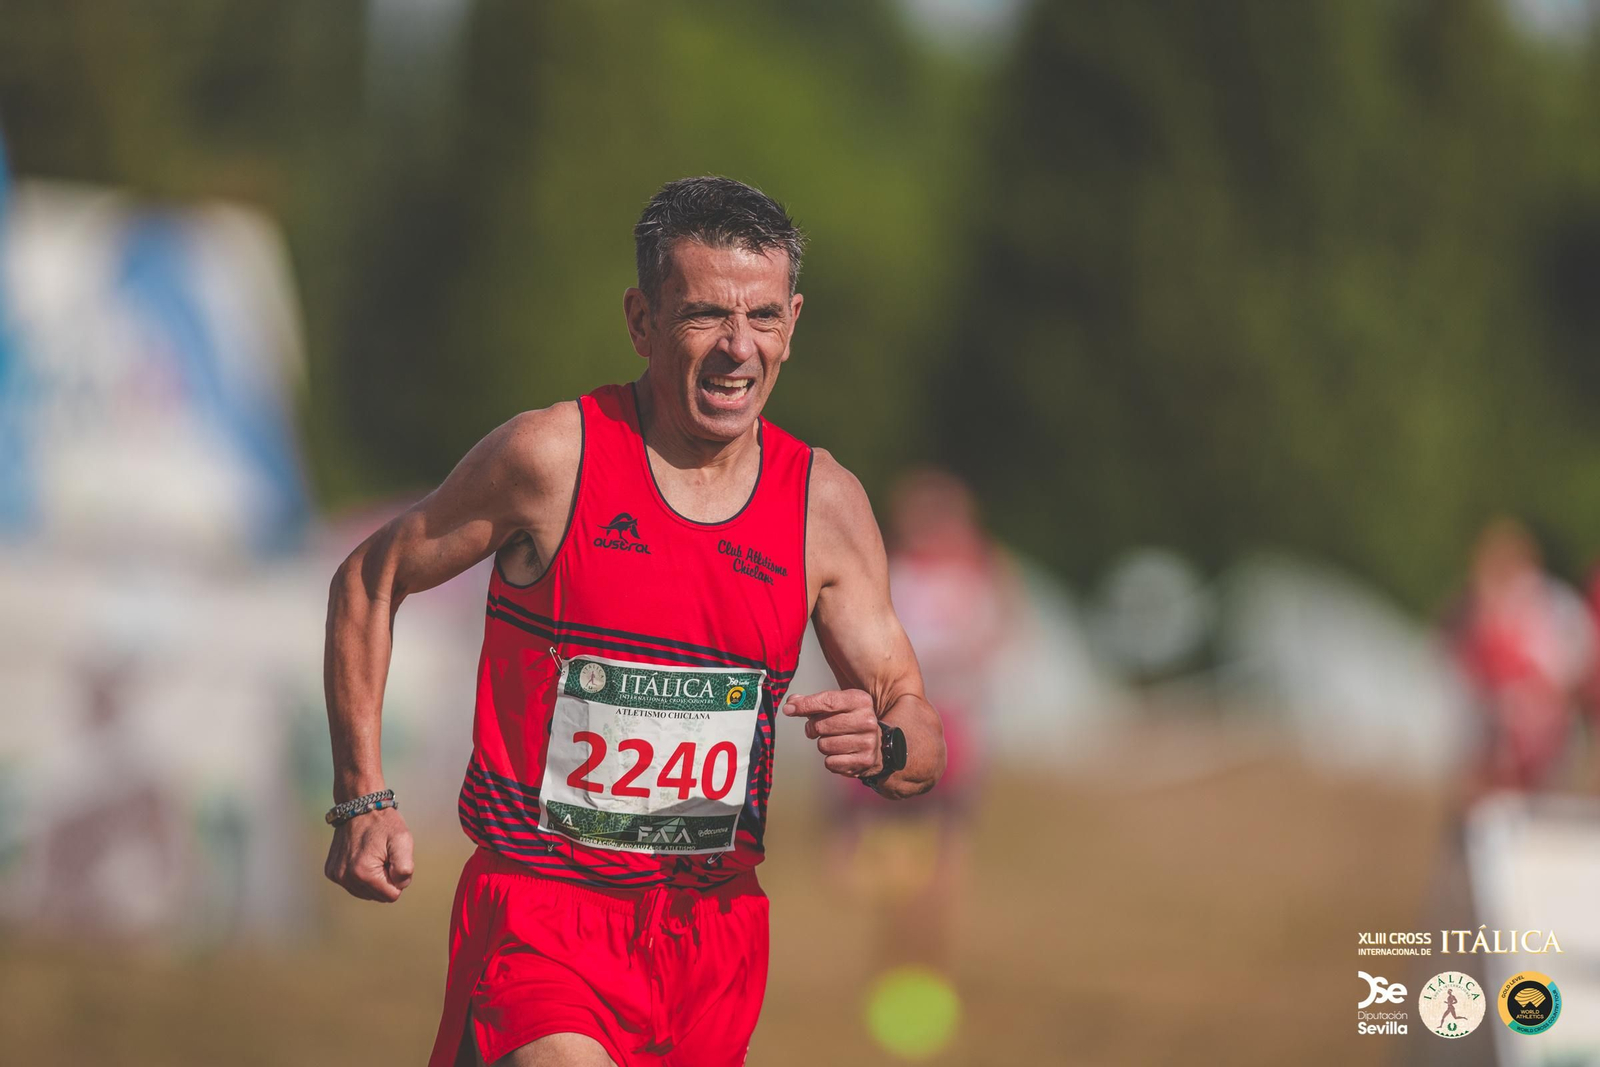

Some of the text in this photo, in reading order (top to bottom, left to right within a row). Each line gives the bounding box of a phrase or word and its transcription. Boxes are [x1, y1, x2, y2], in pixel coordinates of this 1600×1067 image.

[593, 537, 651, 555] austral
[717, 539, 788, 577] Club Atletismo
[619, 671, 715, 698] ITÁLICA
[619, 694, 668, 703] INTERNATIONAL
[615, 708, 710, 720] ATLETISMO CHICLANA
[566, 731, 738, 801] 2240
